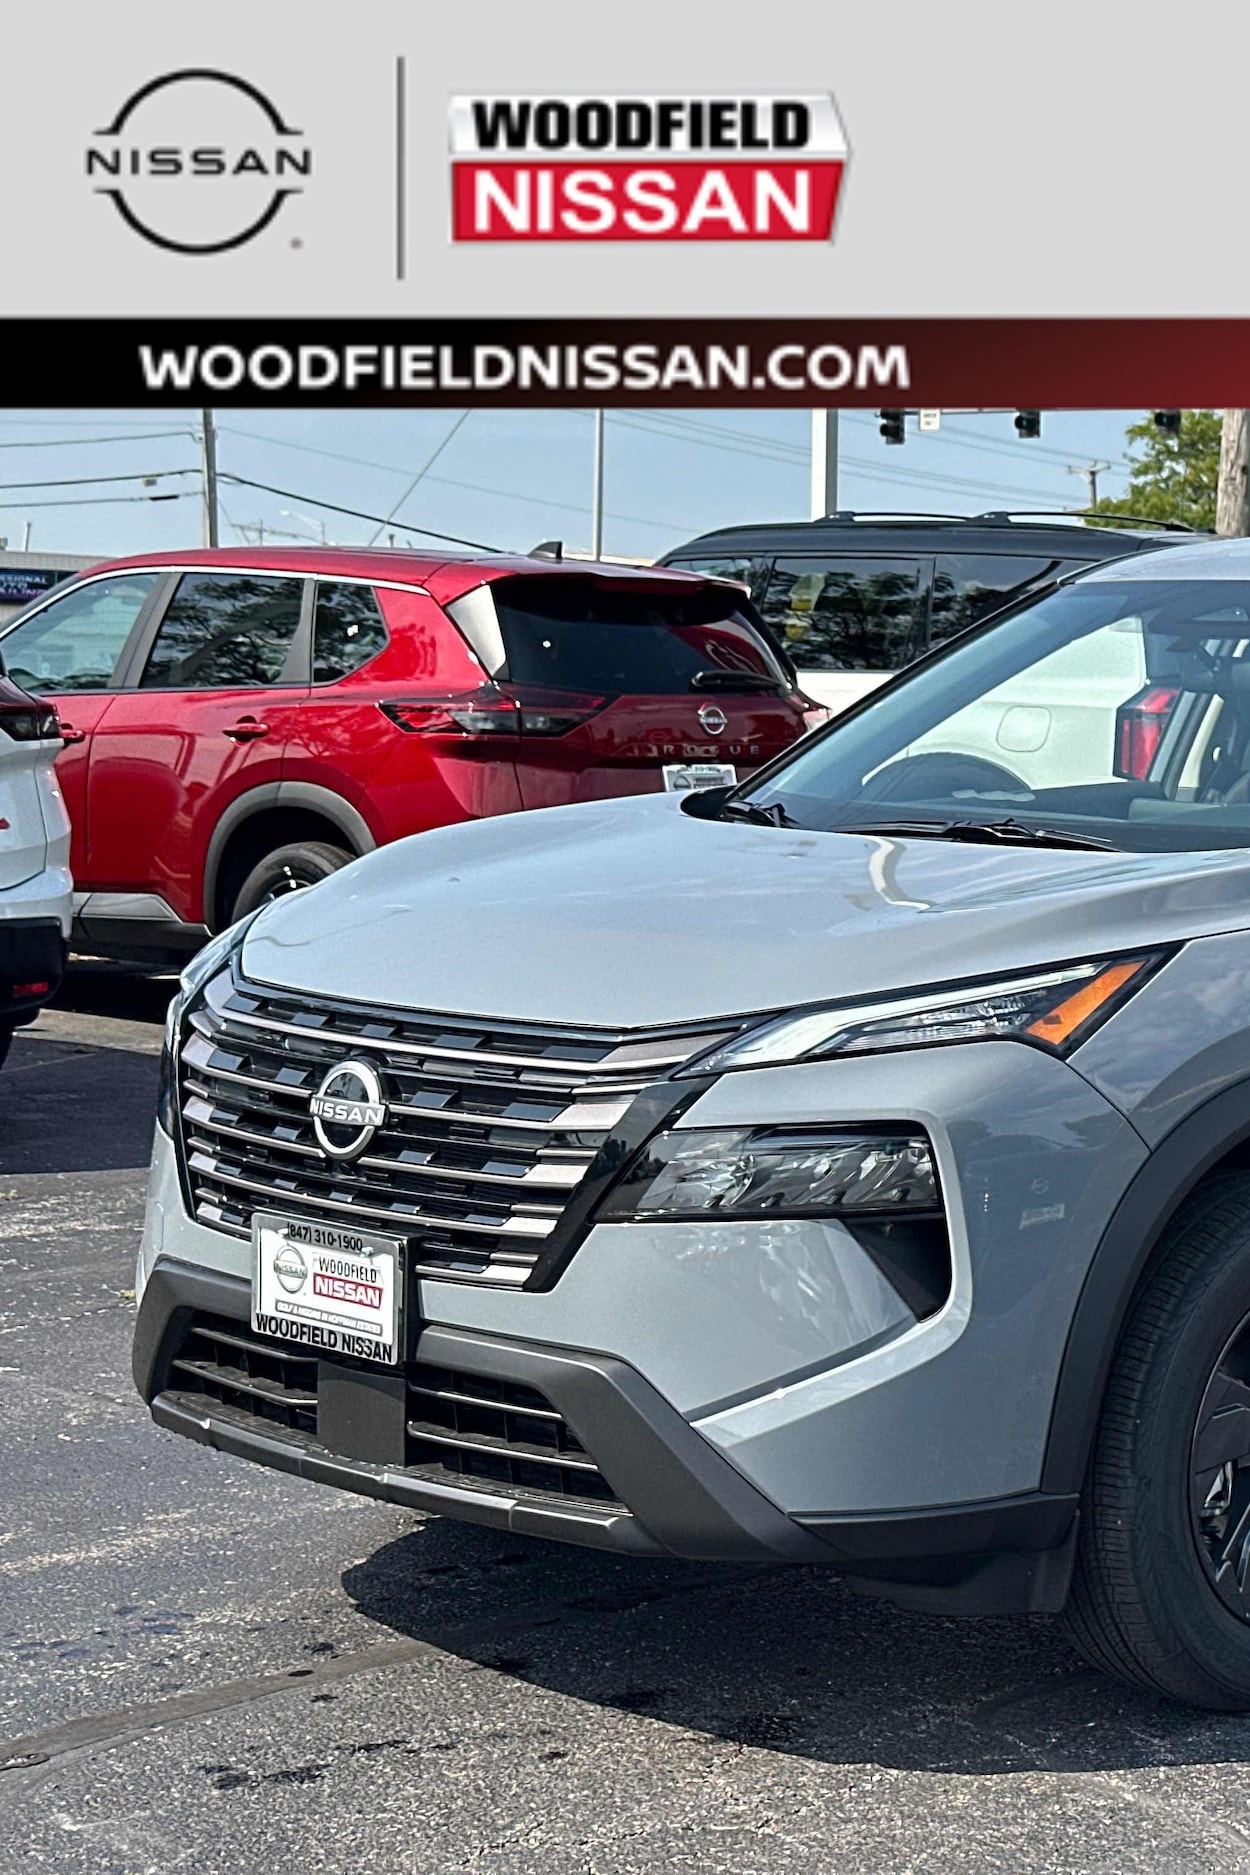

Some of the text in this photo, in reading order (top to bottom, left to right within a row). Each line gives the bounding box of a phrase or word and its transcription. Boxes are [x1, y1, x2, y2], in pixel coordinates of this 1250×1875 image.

[663, 744, 760, 755] ROGUE
[309, 1097, 382, 1124] NISSAN
[287, 1222, 364, 1251] (847) 310-1900
[318, 1255, 378, 1284] WOODFIELD
[314, 1276, 381, 1309] NISSAN
[256, 1313, 339, 1348] WOODFIELD
[341, 1333, 393, 1364] NISSAN
